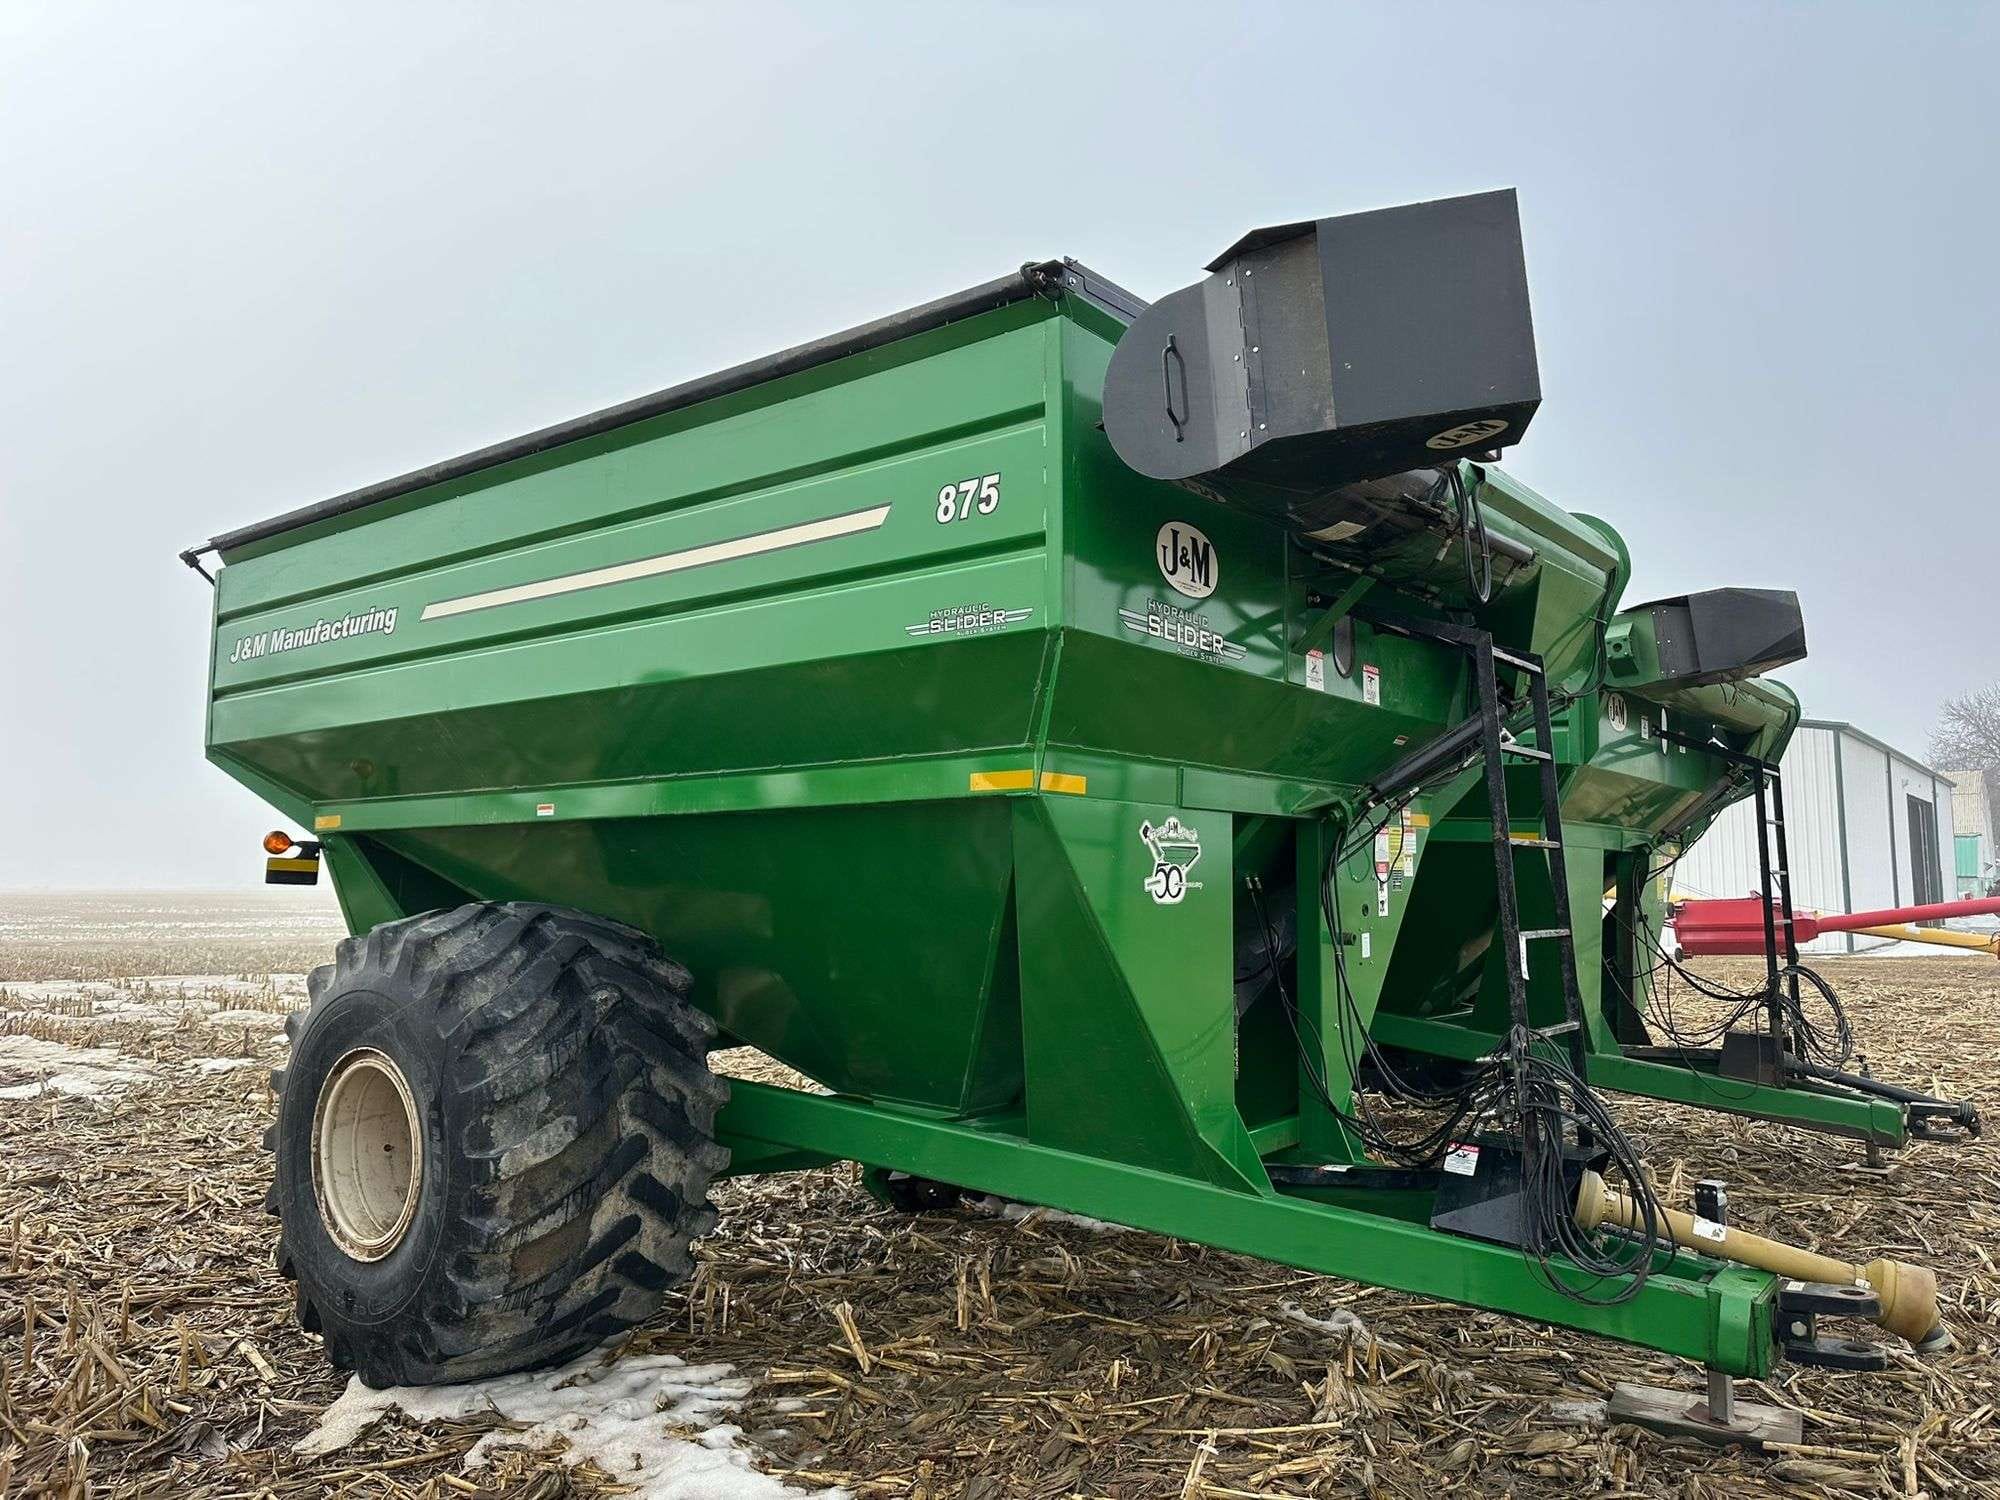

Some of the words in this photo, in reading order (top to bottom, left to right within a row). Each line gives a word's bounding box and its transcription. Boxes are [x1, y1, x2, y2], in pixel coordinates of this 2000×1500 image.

[1434, 421, 1500, 447] J&M
[936, 472, 1001, 525] 875
[1161, 528, 1211, 589] J&M
[928, 608, 1007, 635] SLIDER
[929, 601, 990, 620] HYDRAULIC
[1147, 598, 1209, 628] HYDRAULIC
[229, 632, 268, 664] J&M
[269, 605, 399, 655] Manufacturing
[1147, 613, 1225, 656] SLIDER
[1154, 862, 1183, 899] 50
